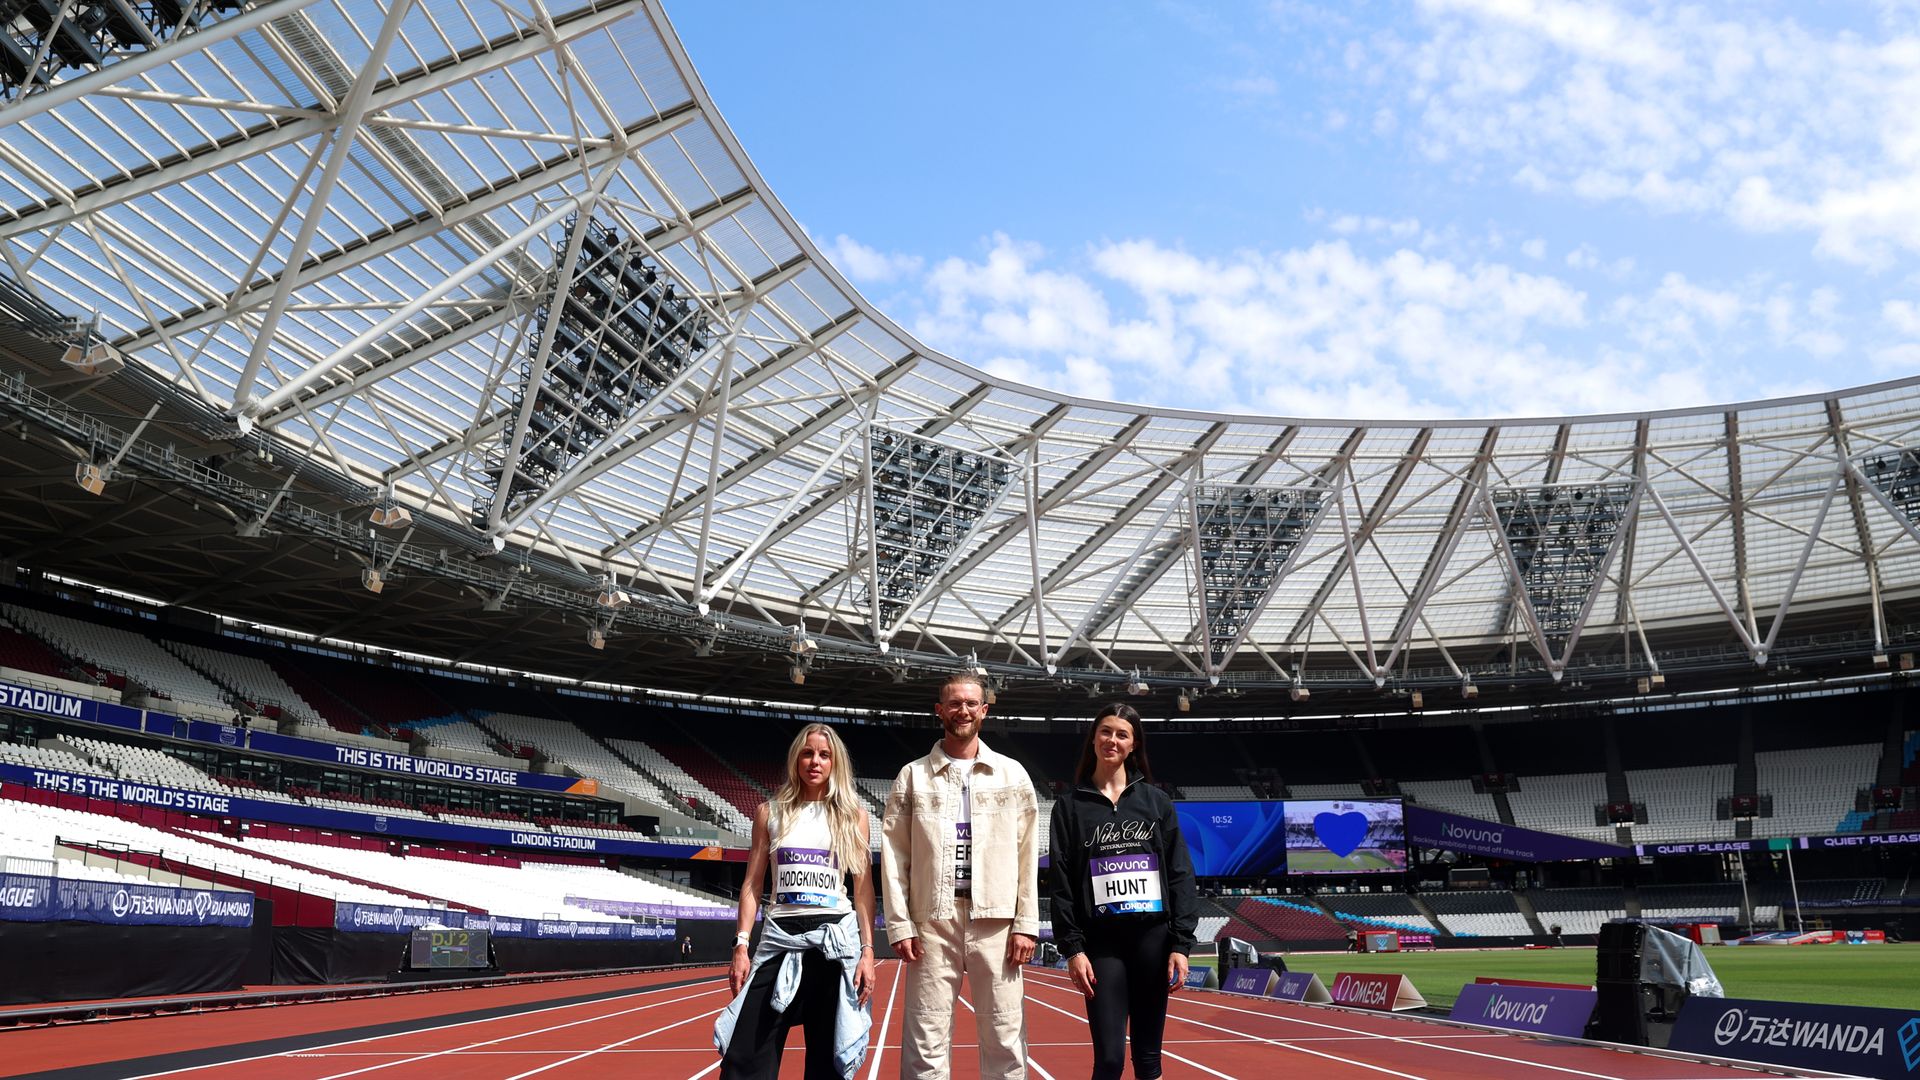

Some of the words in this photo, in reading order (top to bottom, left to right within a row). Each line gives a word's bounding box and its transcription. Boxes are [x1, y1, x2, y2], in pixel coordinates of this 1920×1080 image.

[0, 684, 82, 717] STADIUM
[335, 746, 367, 766] THIS
[369, 752, 382, 767] IS
[385, 754, 412, 772] THE
[414, 759, 474, 780] WORLD'S
[475, 768, 518, 786] STAGE
[34, 771, 70, 792] THIS
[72, 777, 86, 793] IS
[89, 779, 119, 799] THE
[121, 784, 185, 808] WORLD'S
[186, 793, 230, 813] STAGE
[1211, 815, 1233, 824] 10:52
[511, 832, 552, 847] LONDON
[552, 836, 596, 850] STADIUM
[1085, 822, 1121, 847] Nike
[1121, 820, 1156, 841] Club
[1442, 822, 1503, 844] Novuna
[1824, 836, 1866, 847] QUIET
[1869, 833, 1920, 845] PLEAS
[1100, 841, 1142, 851] INTERNATIONAL
[1412, 835, 1437, 847] Backing
[1439, 839, 1467, 849] ambition
[1478, 844, 1491, 853] and
[1492, 846, 1502, 854] off
[1503, 847, 1515, 856] the
[1516, 849, 1535, 858] track
[1657, 844, 1695, 854] QUIET
[1699, 841, 1750, 852] PLEASE
[1098, 860, 1149, 873] Novuna
[779, 870, 837, 891] HODGKINSON
[1105, 878, 1148, 897] HUNT
[154, 896, 194, 915] WANDA
[210, 901, 251, 917] DIAMOND
[796, 894, 830, 904] LONDON
[1120, 902, 1154, 911] LONDON
[432, 932, 453, 946] DJ
[459, 932, 468, 946] 2
[1349, 981, 1388, 1005] OMEGA
[1483, 993, 1549, 1024] Novuna
[1741, 1016, 1793, 1046] 万达
[1792, 1021, 1885, 1056] WANDA
